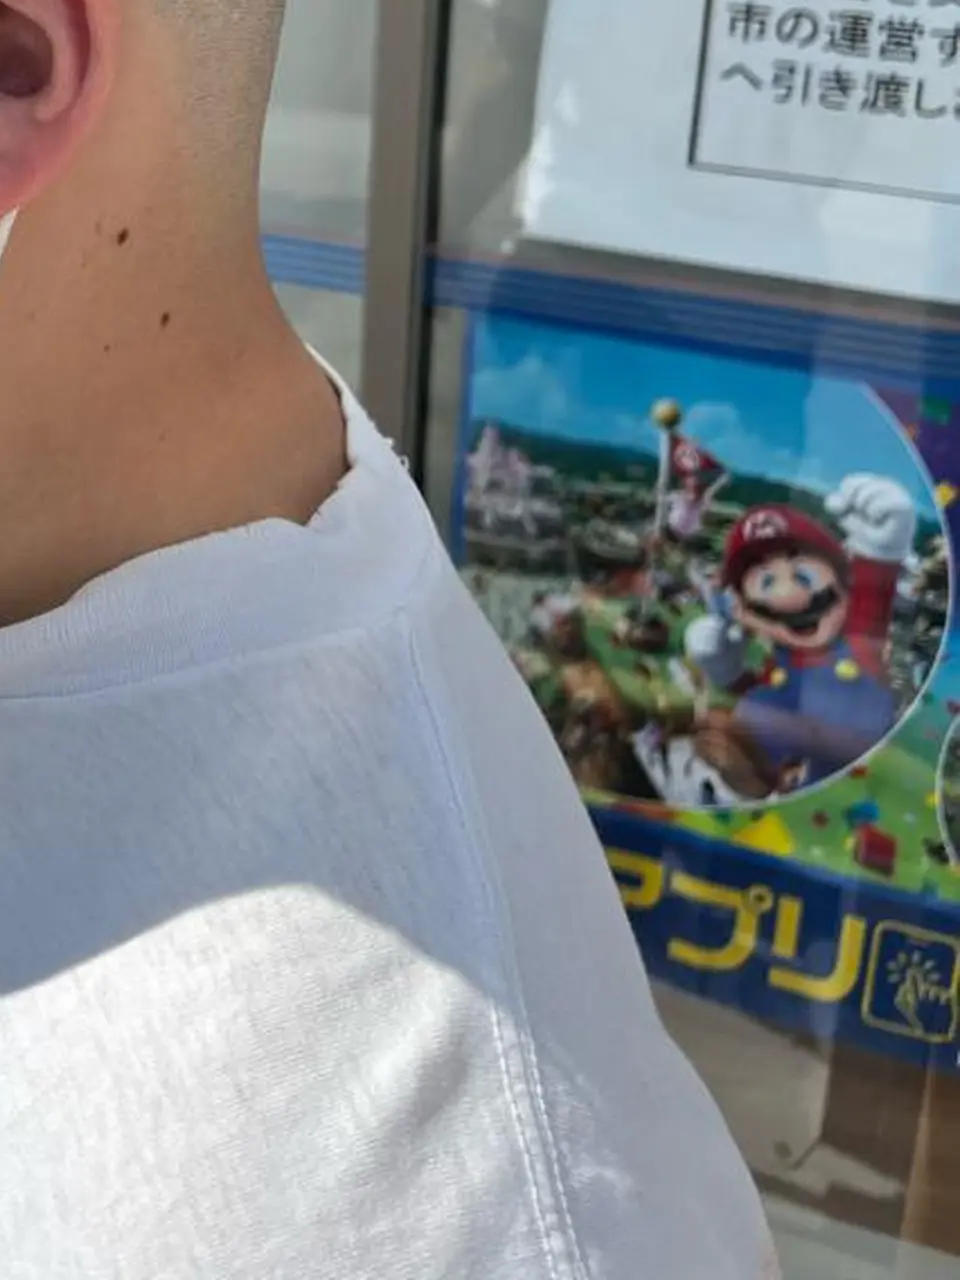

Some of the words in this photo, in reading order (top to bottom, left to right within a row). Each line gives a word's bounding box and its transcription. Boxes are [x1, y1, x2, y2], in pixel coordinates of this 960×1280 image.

[720, 59, 960, 120] へ引き渡し
